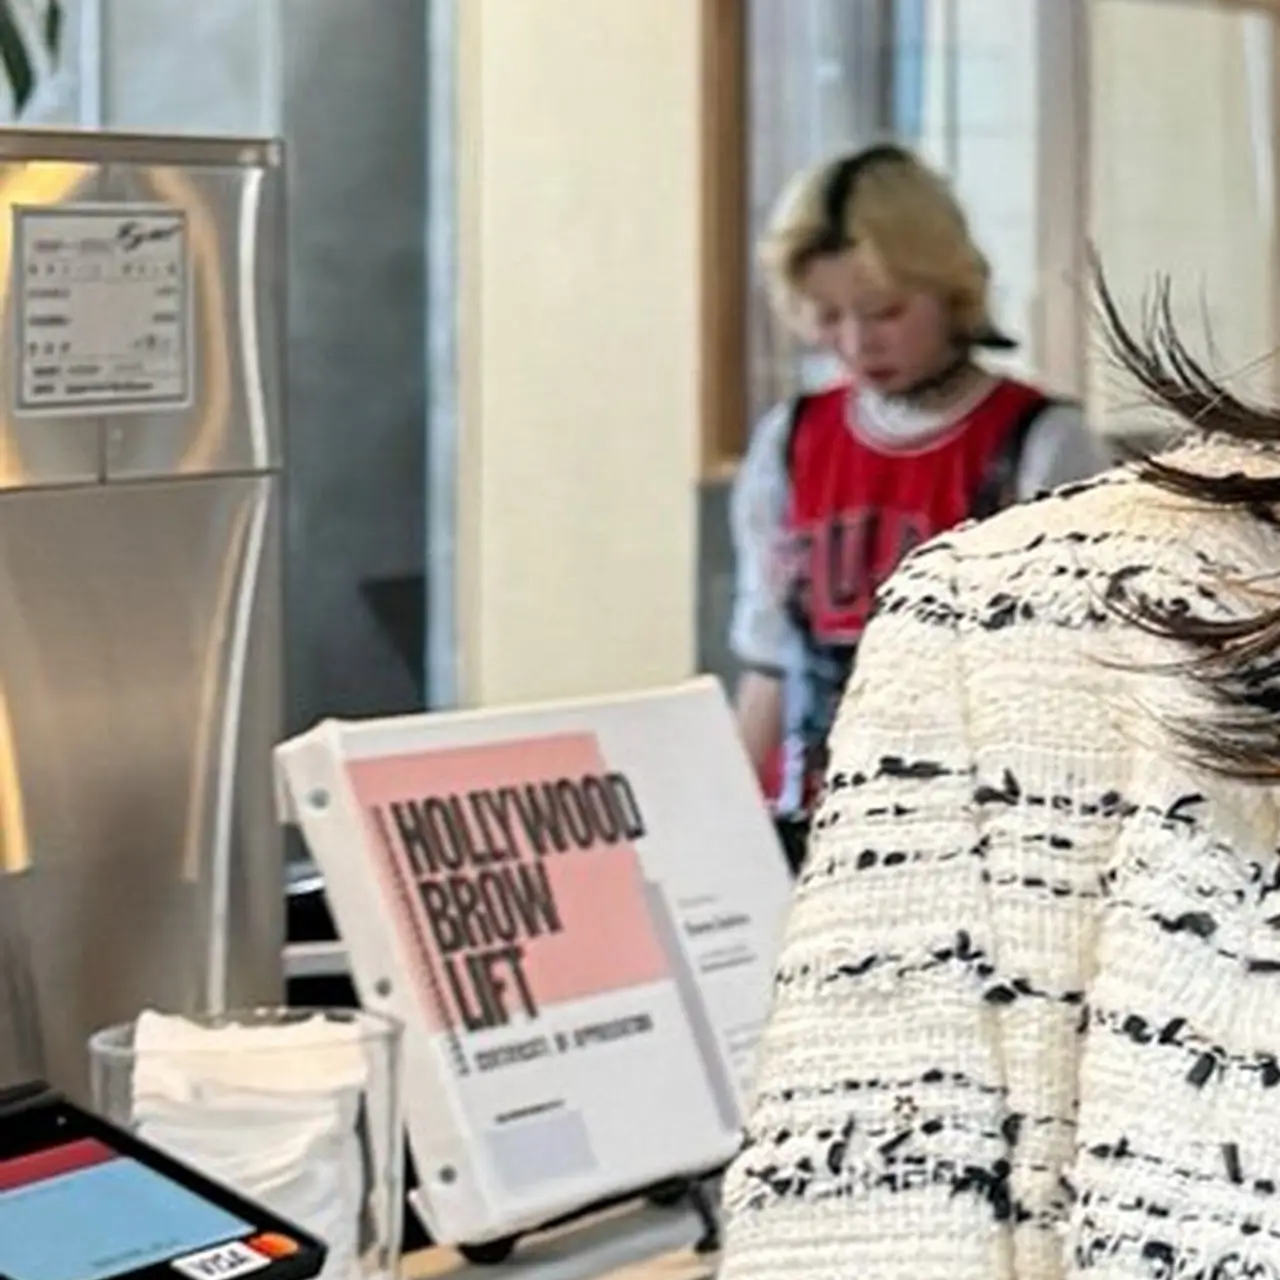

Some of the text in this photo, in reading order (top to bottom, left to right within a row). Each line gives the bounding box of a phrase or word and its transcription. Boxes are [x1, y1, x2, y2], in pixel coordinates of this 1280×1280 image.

[390, 772, 645, 874] HOLLYWOOD
[418, 862, 563, 953] BROW
[443, 945, 540, 1032] LIFT
